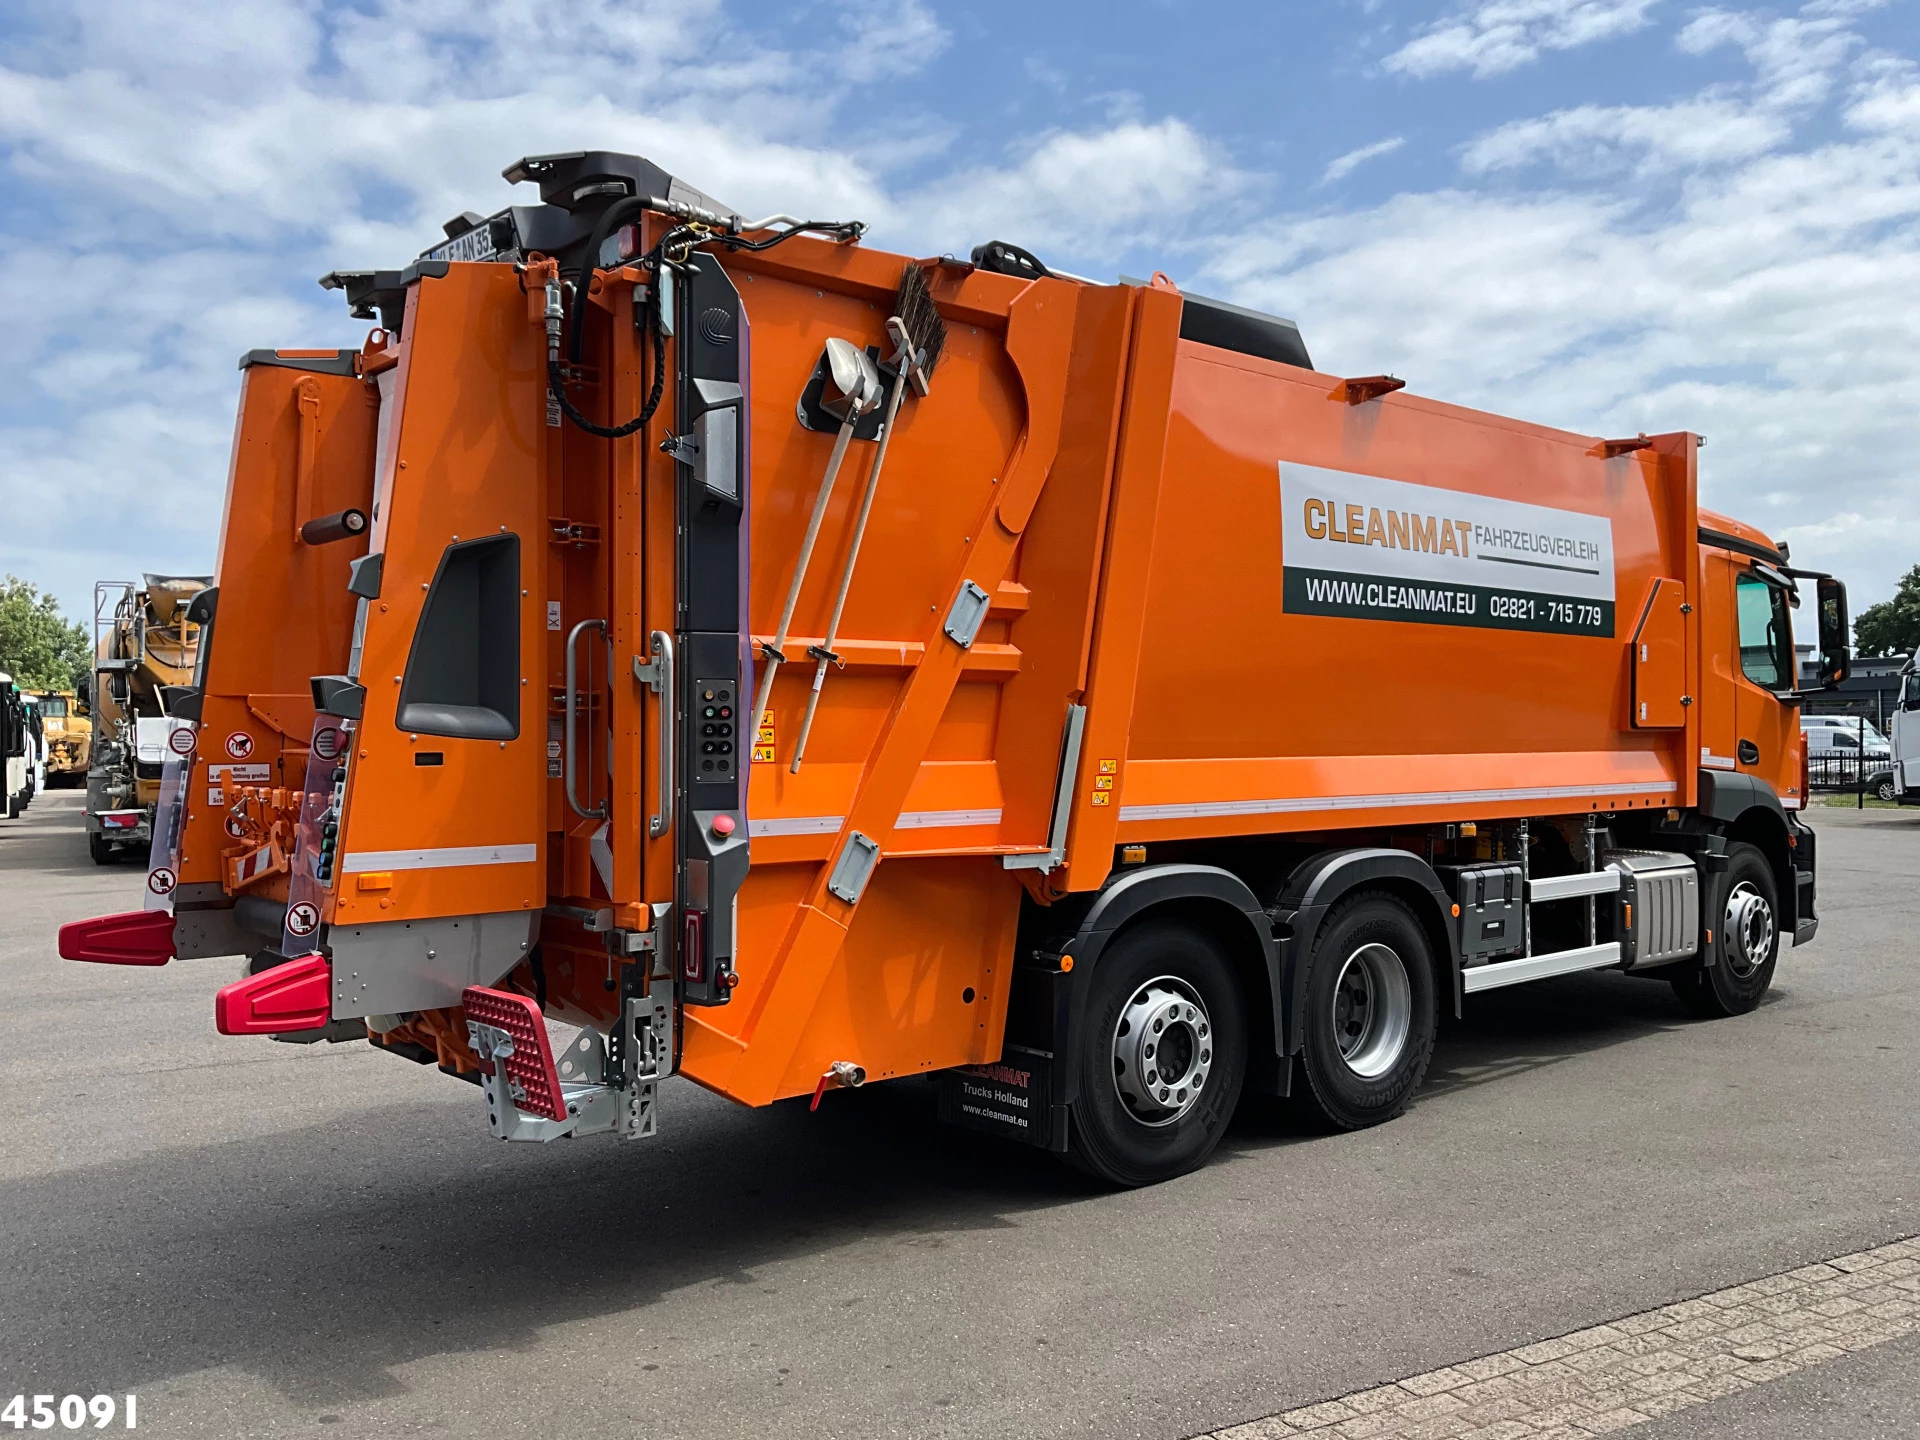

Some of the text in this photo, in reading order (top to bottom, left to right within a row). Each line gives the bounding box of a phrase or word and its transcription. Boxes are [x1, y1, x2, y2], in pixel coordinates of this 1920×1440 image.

[462, 235, 475, 261] AN
[475, 228, 494, 256] 35
[1304, 498, 1599, 562] CLEANMAT FAHRZEUGVERLEIH
[1306, 577, 1476, 614] WWW.CLEANMAT.EU
[1490, 596, 1535, 620] 02821
[1548, 601, 1573, 624] 715
[1577, 605, 1602, 626] 779
[970, 1064, 1030, 1088] LEANMAT
[963, 1082, 1029, 1108] Trucks Holland
[962, 1103, 1028, 1128] www.cleanmat.eu
